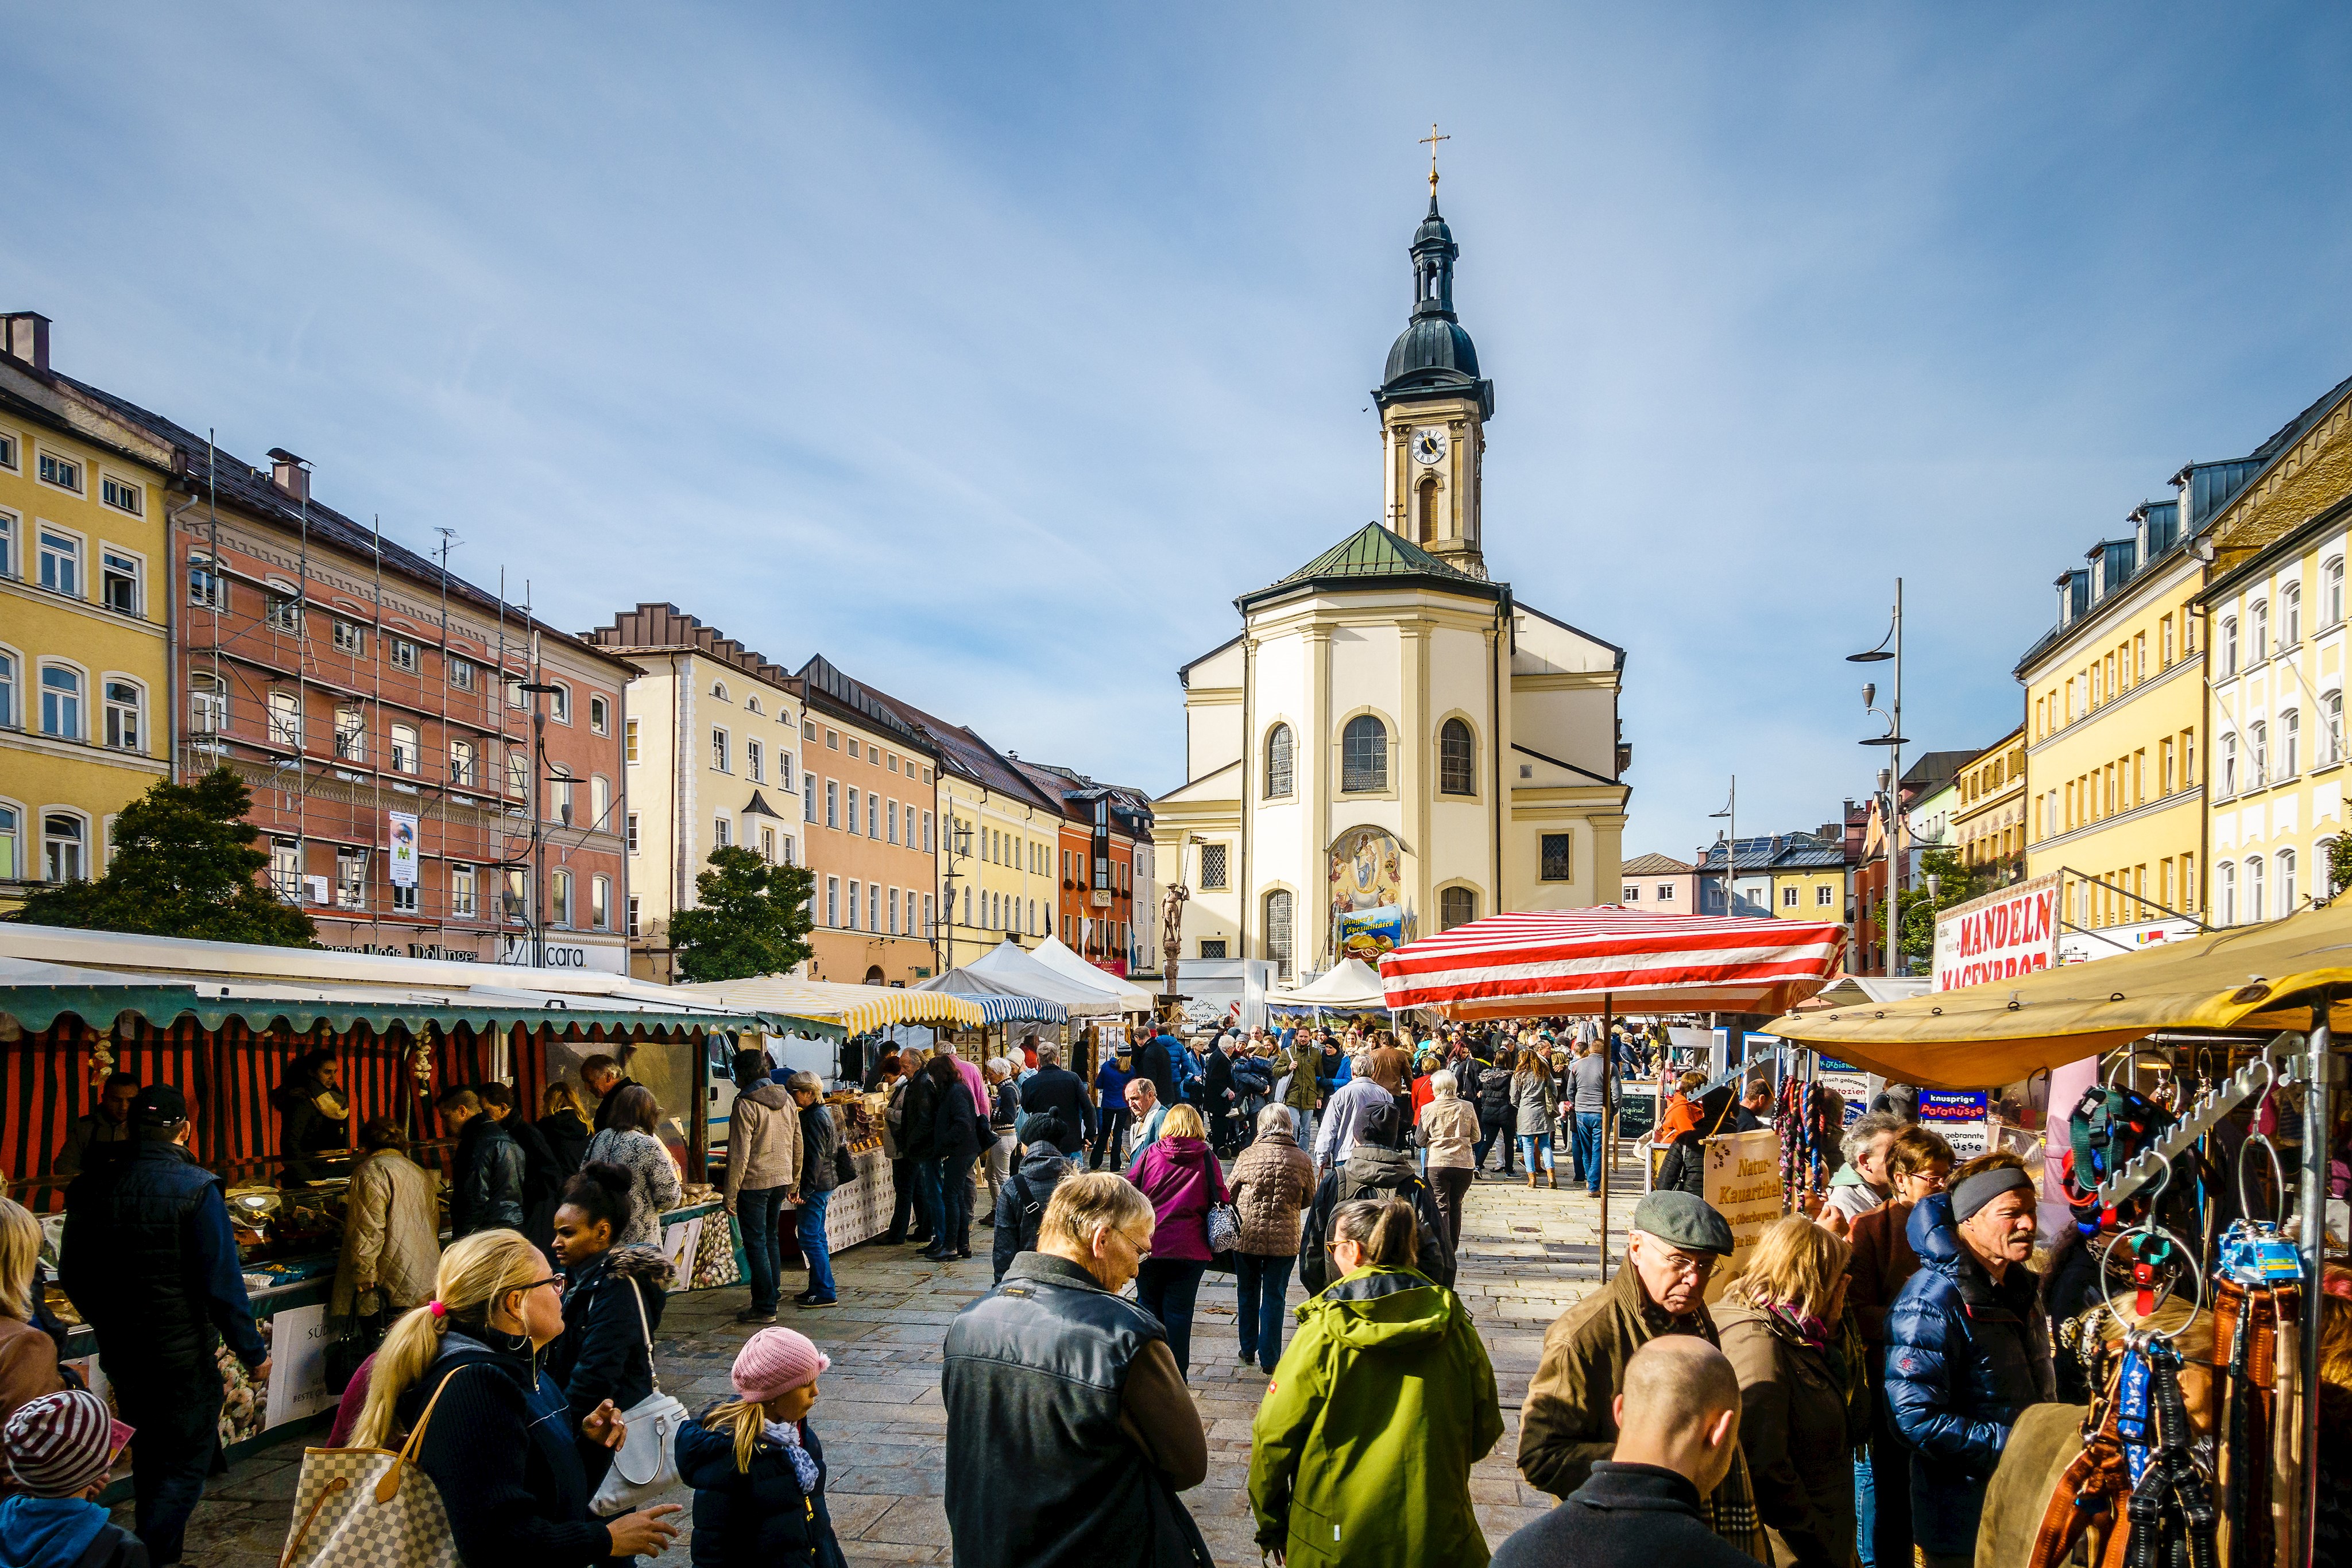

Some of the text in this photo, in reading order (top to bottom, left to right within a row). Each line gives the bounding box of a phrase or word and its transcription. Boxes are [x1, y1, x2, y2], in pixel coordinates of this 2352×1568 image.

[1347, 921, 1394, 934] Spezialitäten
[1960, 890, 2054, 958] MANDELN
[413, 943, 479, 962] Dollinger
[1819, 1060, 1858, 1070] Kürbisk
[1840, 1078, 1868, 1089] gebrannte
[1825, 1087, 1866, 1095] tazien
[1930, 1094, 1975, 1104] knusprige
[1620, 1106, 1645, 1115] Original
[1844, 1105, 1864, 1115] rannte
[1950, 1139, 1982, 1151] üsse
[1737, 1158, 1770, 1177] Natur-
[1719, 1178, 1781, 1205] Kauartikel
[1736, 1210, 1778, 1225] Oberbayern
[293, 1391, 314, 1404] BESTE
